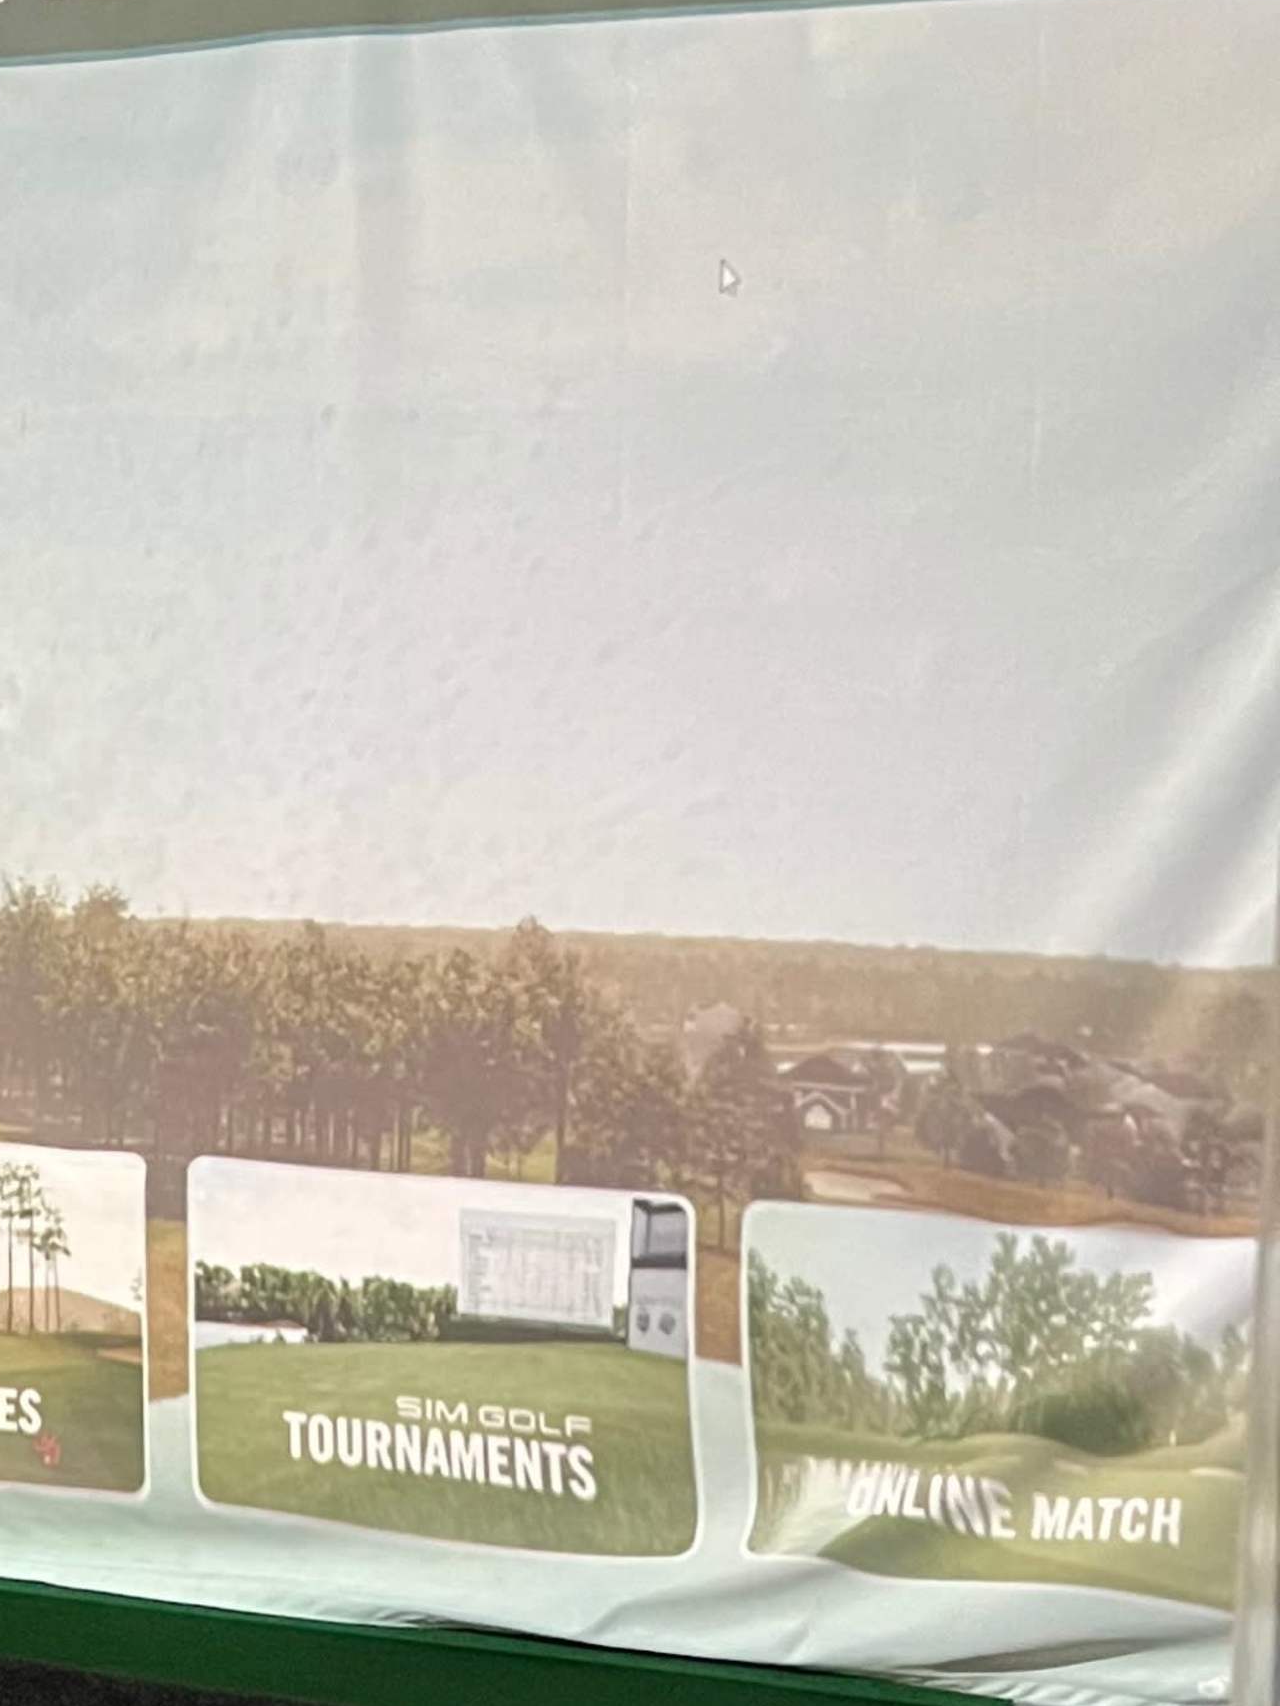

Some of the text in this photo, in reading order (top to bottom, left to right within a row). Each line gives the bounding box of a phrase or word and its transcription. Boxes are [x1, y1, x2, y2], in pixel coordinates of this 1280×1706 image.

[395, 1395, 593, 1438] SIM GOLF
[282, 1409, 598, 1501] TOURNAMENTS
[846, 1471, 1183, 1546] ONLINE MATCH
